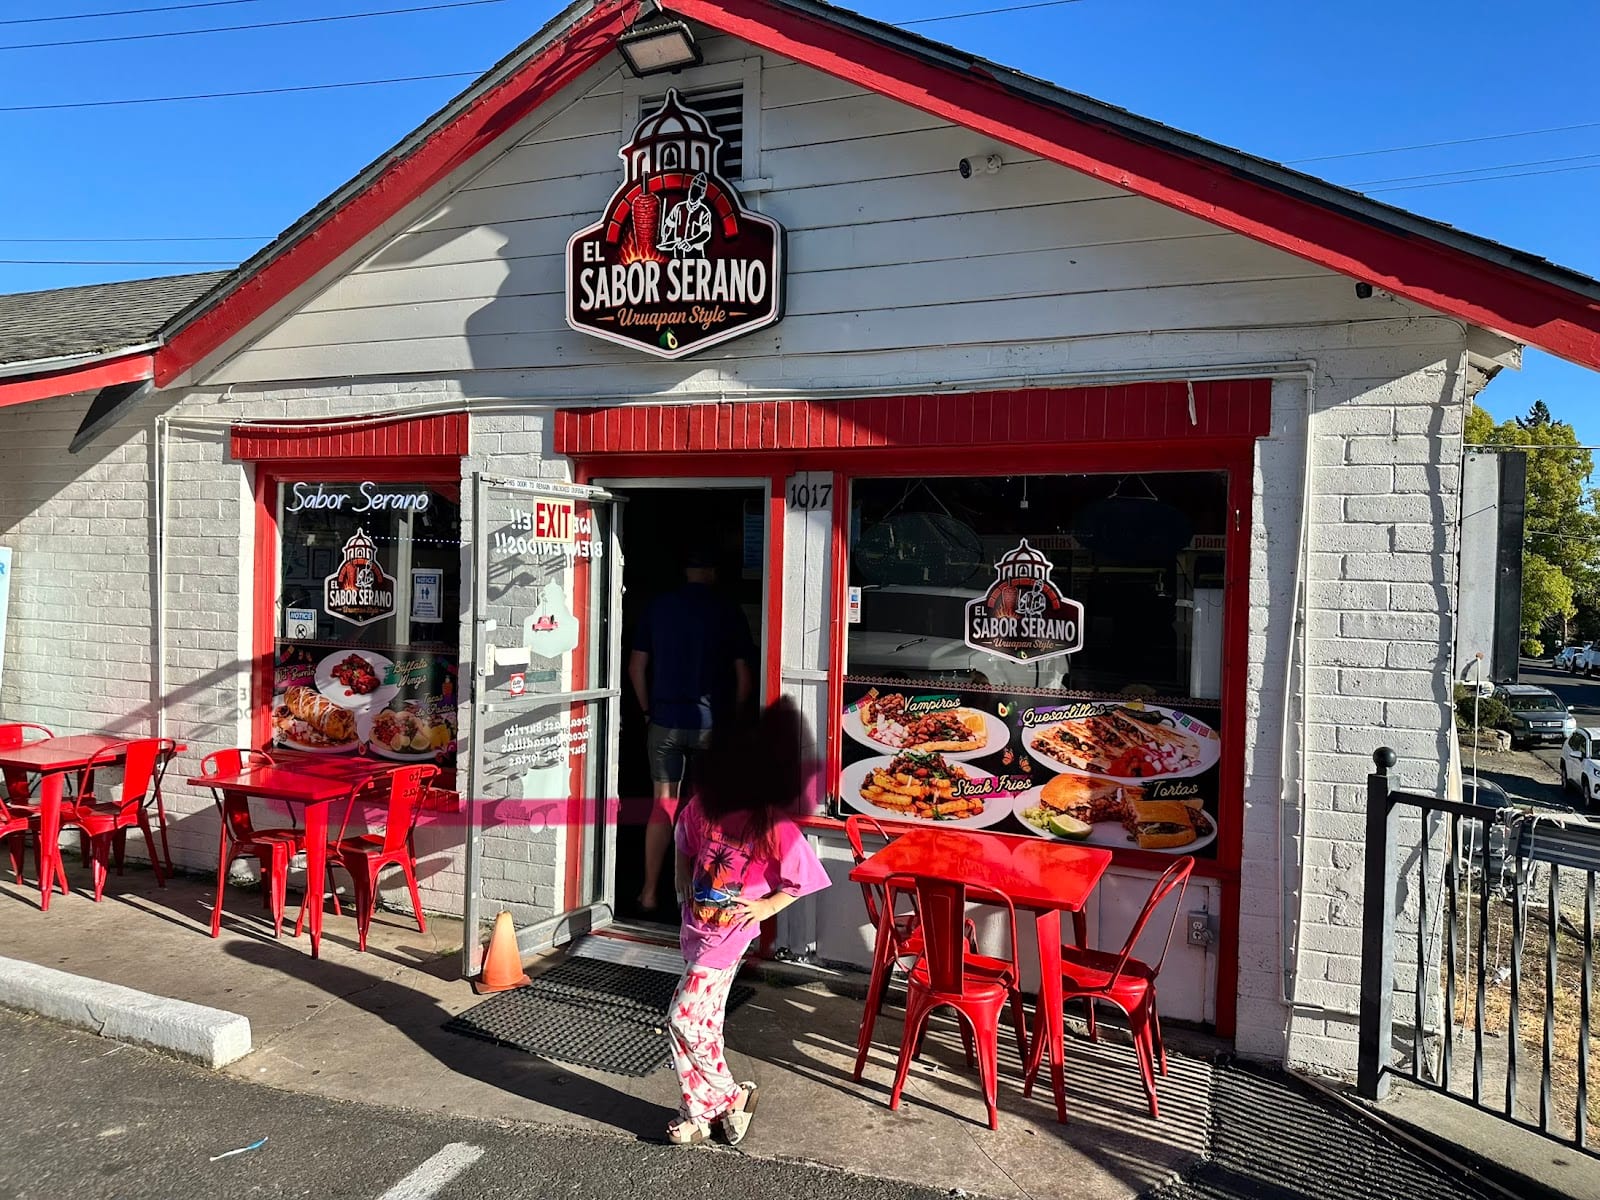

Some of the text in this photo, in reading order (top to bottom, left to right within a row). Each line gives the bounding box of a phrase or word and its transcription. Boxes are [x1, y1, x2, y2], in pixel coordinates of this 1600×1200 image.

[583, 241, 605, 262] EL
[579, 257, 767, 311] SABOR SERANO
[617, 304, 726, 331] Uruapan Style
[286, 481, 429, 512] Sabor Serano
[790, 483, 832, 509] 1017
[536, 502, 571, 538] EXIT
[330, 580, 339, 589] EL
[329, 589, 392, 607] SABOR SERANO
[290, 611, 312, 620] NOTICE
[975, 605, 987, 616] EL
[972, 617, 1076, 642] SABOR SERANO
[993, 639, 1055, 652] Uruapan Style
[392, 658, 428, 674] Buffalo
[397, 674, 427, 690] Wings
[423, 692, 444, 703] Tacos
[904, 696, 961, 716] Vampiros
[1022, 703, 1105, 728] Quesadillas
[953, 775, 1032, 797] Steak Fries
[1152, 780, 1199, 798] Tortas
